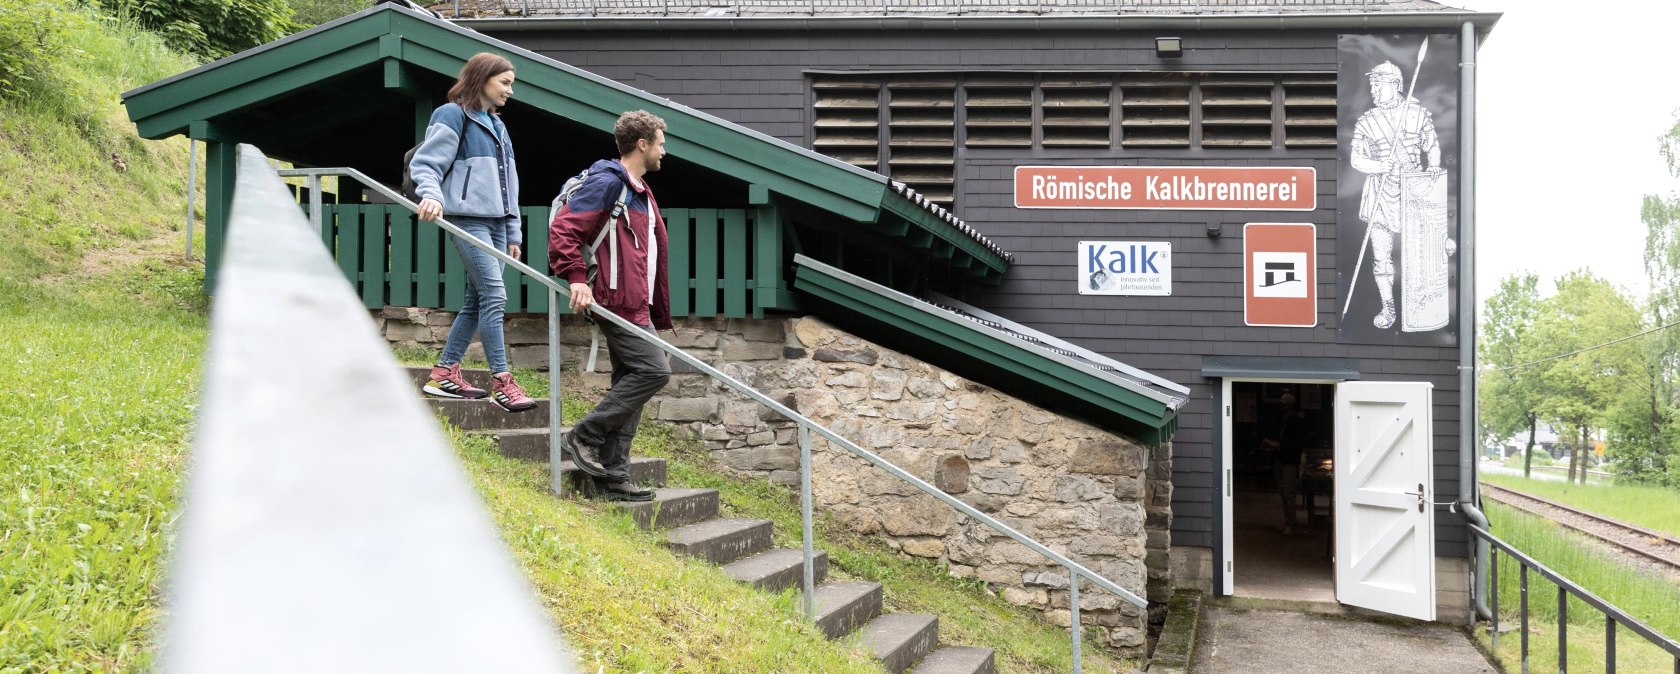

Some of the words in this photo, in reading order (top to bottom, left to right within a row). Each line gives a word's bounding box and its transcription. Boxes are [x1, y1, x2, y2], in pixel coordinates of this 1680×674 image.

[1033, 175, 1131, 200] Römische
[1145, 176, 1297, 201] Kalkbrennerei
[1089, 245, 1159, 273] Kalk
